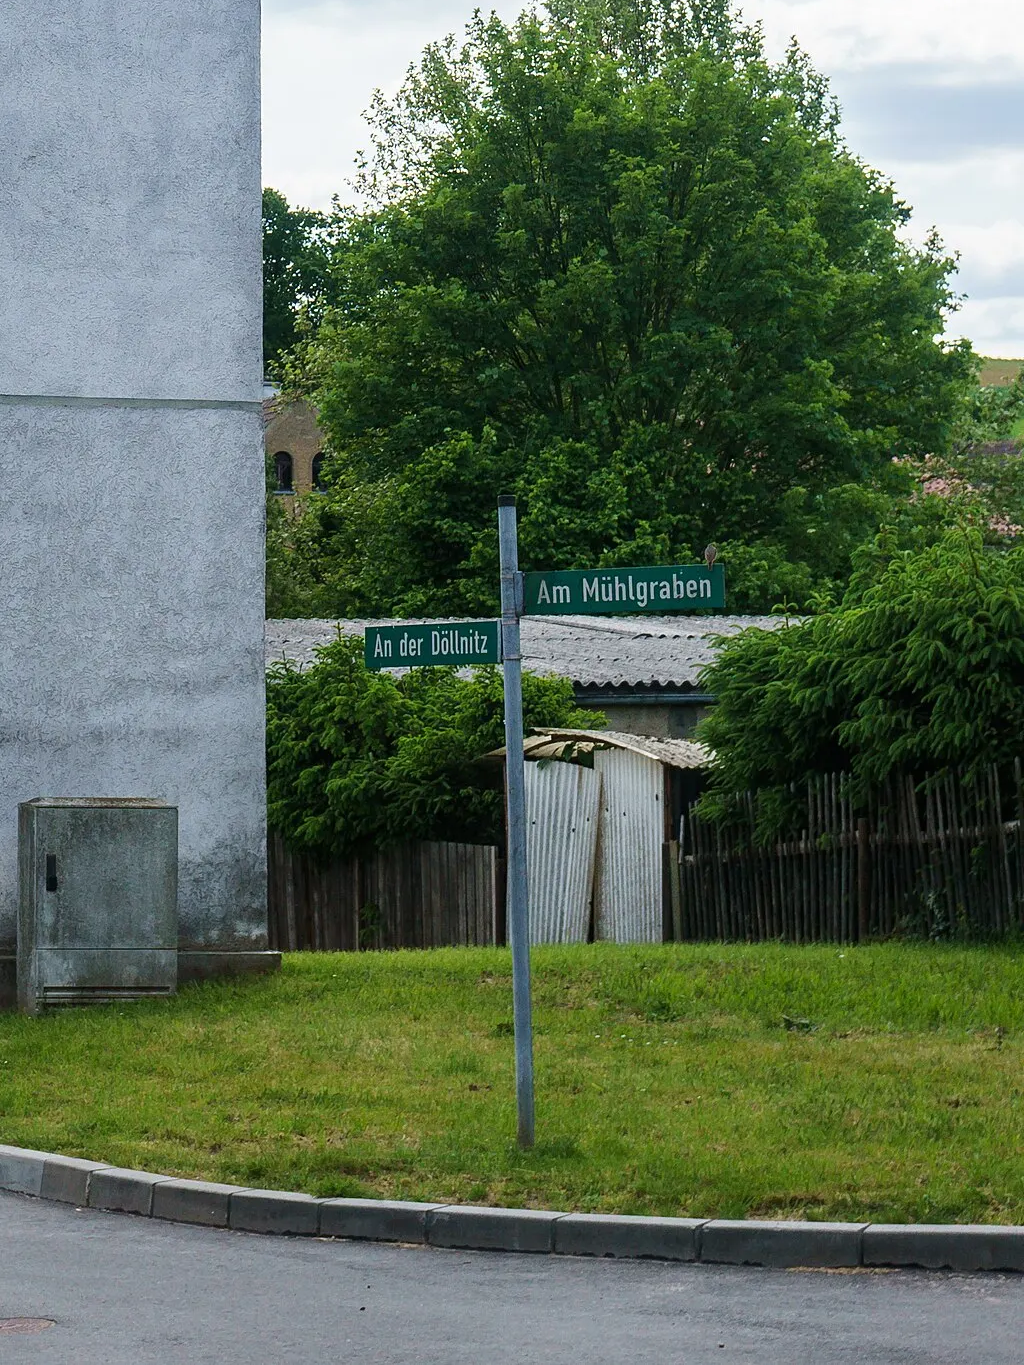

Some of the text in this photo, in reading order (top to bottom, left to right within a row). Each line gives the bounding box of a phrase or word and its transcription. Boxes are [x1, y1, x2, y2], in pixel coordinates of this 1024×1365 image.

[537, 573, 712, 608] Am Mühlgraben
[374, 629, 488, 657] An der Döllnitz
